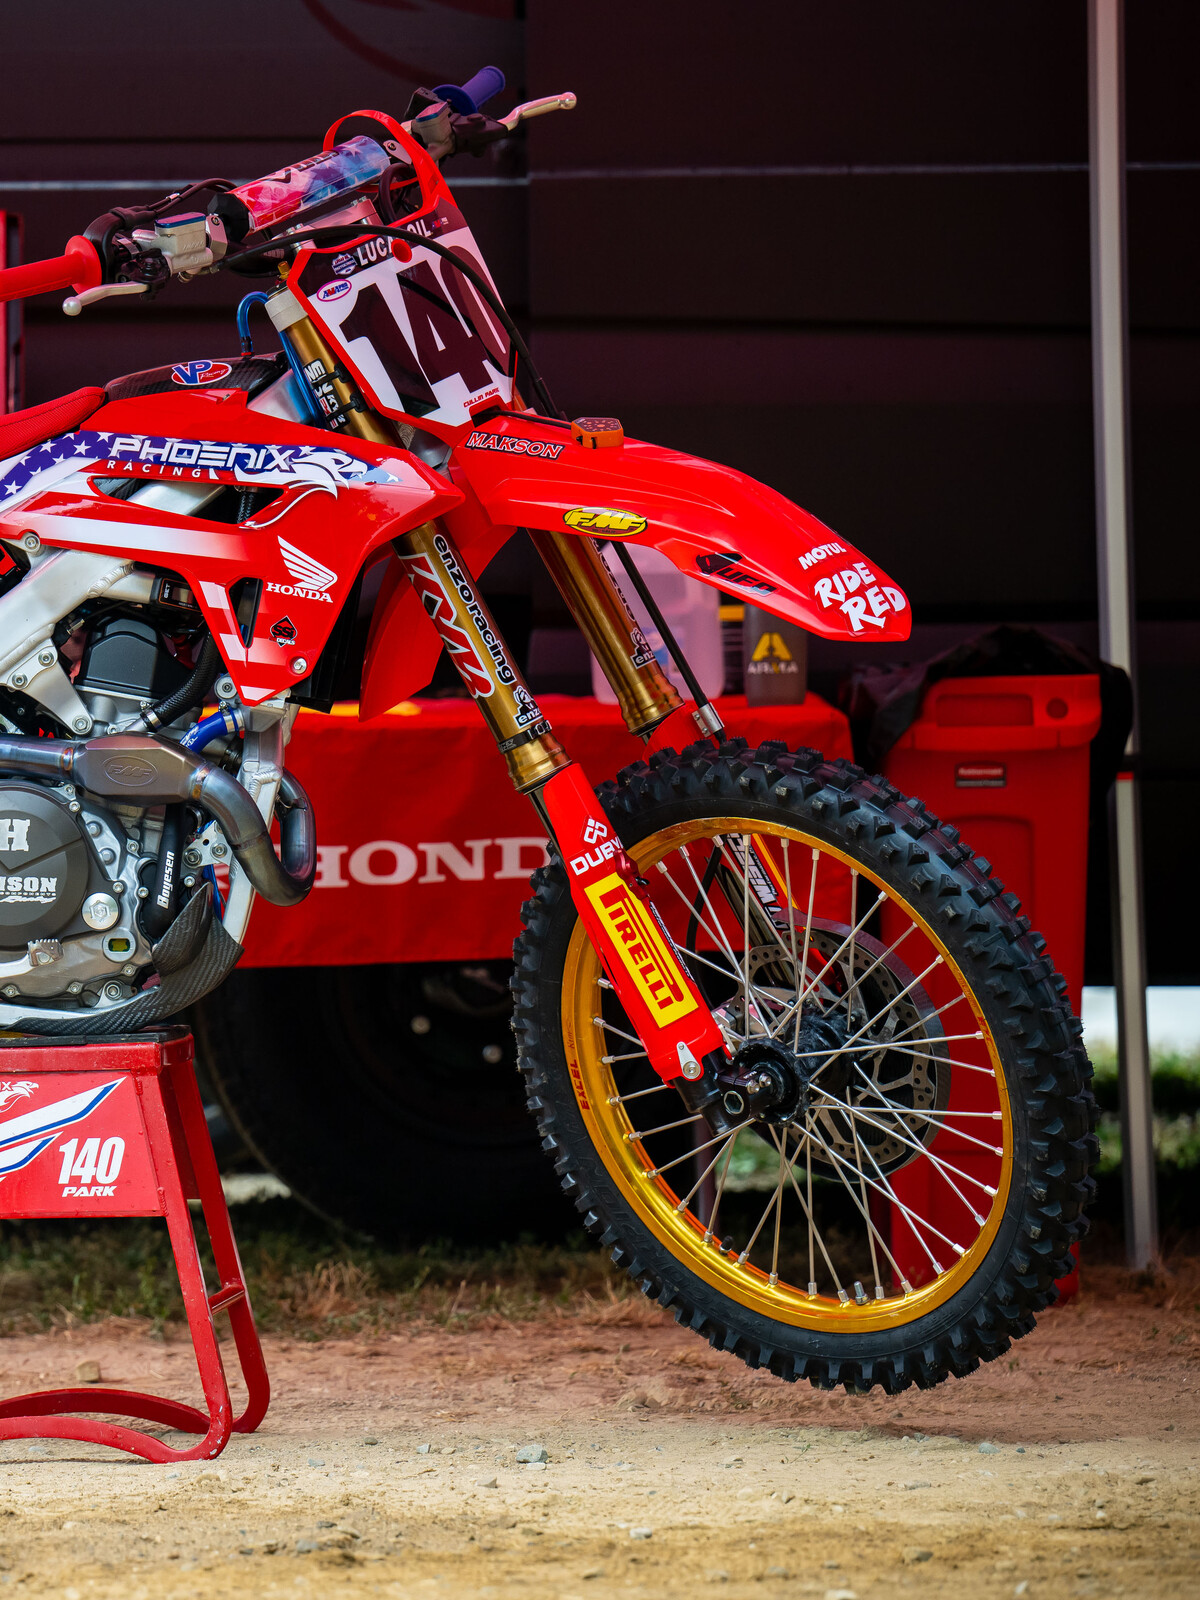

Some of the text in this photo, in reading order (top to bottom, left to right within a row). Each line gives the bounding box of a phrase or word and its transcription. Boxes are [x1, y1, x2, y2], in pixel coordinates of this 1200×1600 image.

[357, 236, 397, 266] LUCA
[339, 245, 513, 418] 140
[172, 360, 213, 384] VP
[485, 387, 500, 398] PARK
[107, 437, 299, 472] PHOENIX
[466, 432, 564, 459] MAKSON
[107, 460, 202, 479] RACING
[565, 511, 648, 530] FMF
[798, 542, 847, 570] MOTUL
[266, 582, 333, 603] HONDA
[716, 567, 778, 594] UFO
[814, 562, 877, 608] RIDE
[398, 553, 496, 699] KYB
[433, 534, 517, 686] enzo racing
[839, 585, 906, 631] RED
[518, 708, 542, 723] enz
[275, 836, 552, 888] HOND
[570, 837, 624, 876] DUBY
[725, 833, 778, 905] WISEC
[156, 850, 176, 910] Boyesen
[599, 884, 684, 1010] PIRELLI
[570, 1059, 590, 1110] EXCEL
[58, 1136, 125, 1184] 140
[62, 1186, 117, 1198] PARK
